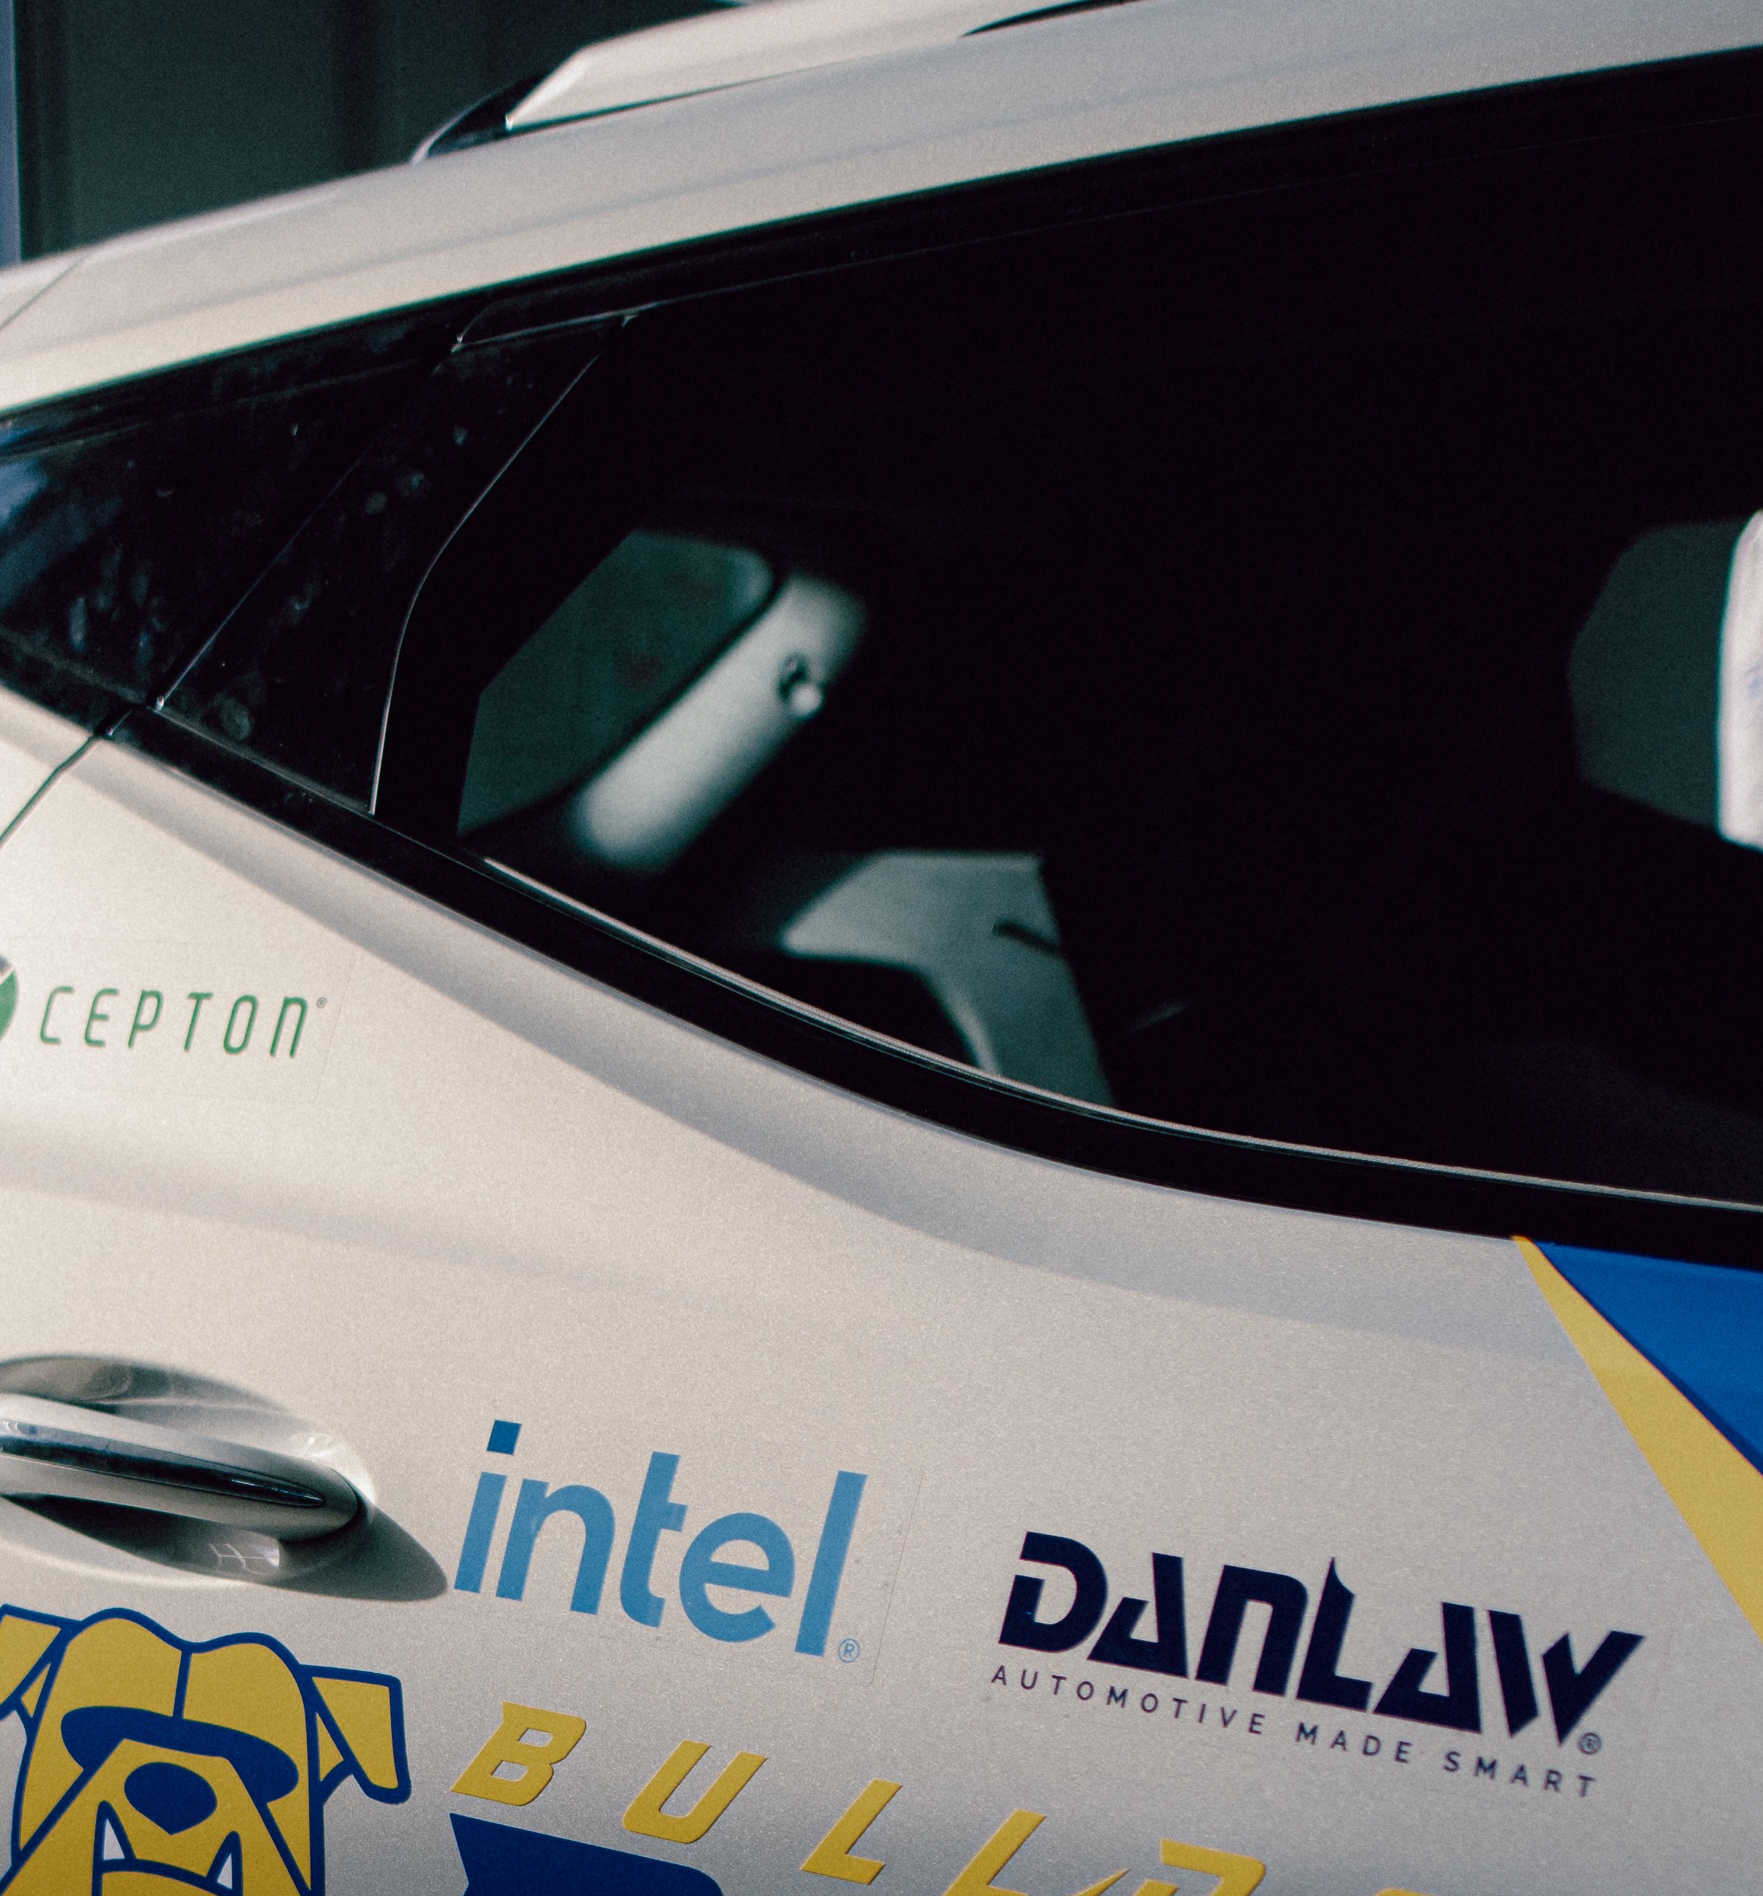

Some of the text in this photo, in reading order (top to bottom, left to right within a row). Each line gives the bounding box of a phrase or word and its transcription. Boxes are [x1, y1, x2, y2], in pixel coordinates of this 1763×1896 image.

[990, 1662, 1599, 1800] AUTOMOTIVE MADE SMART
